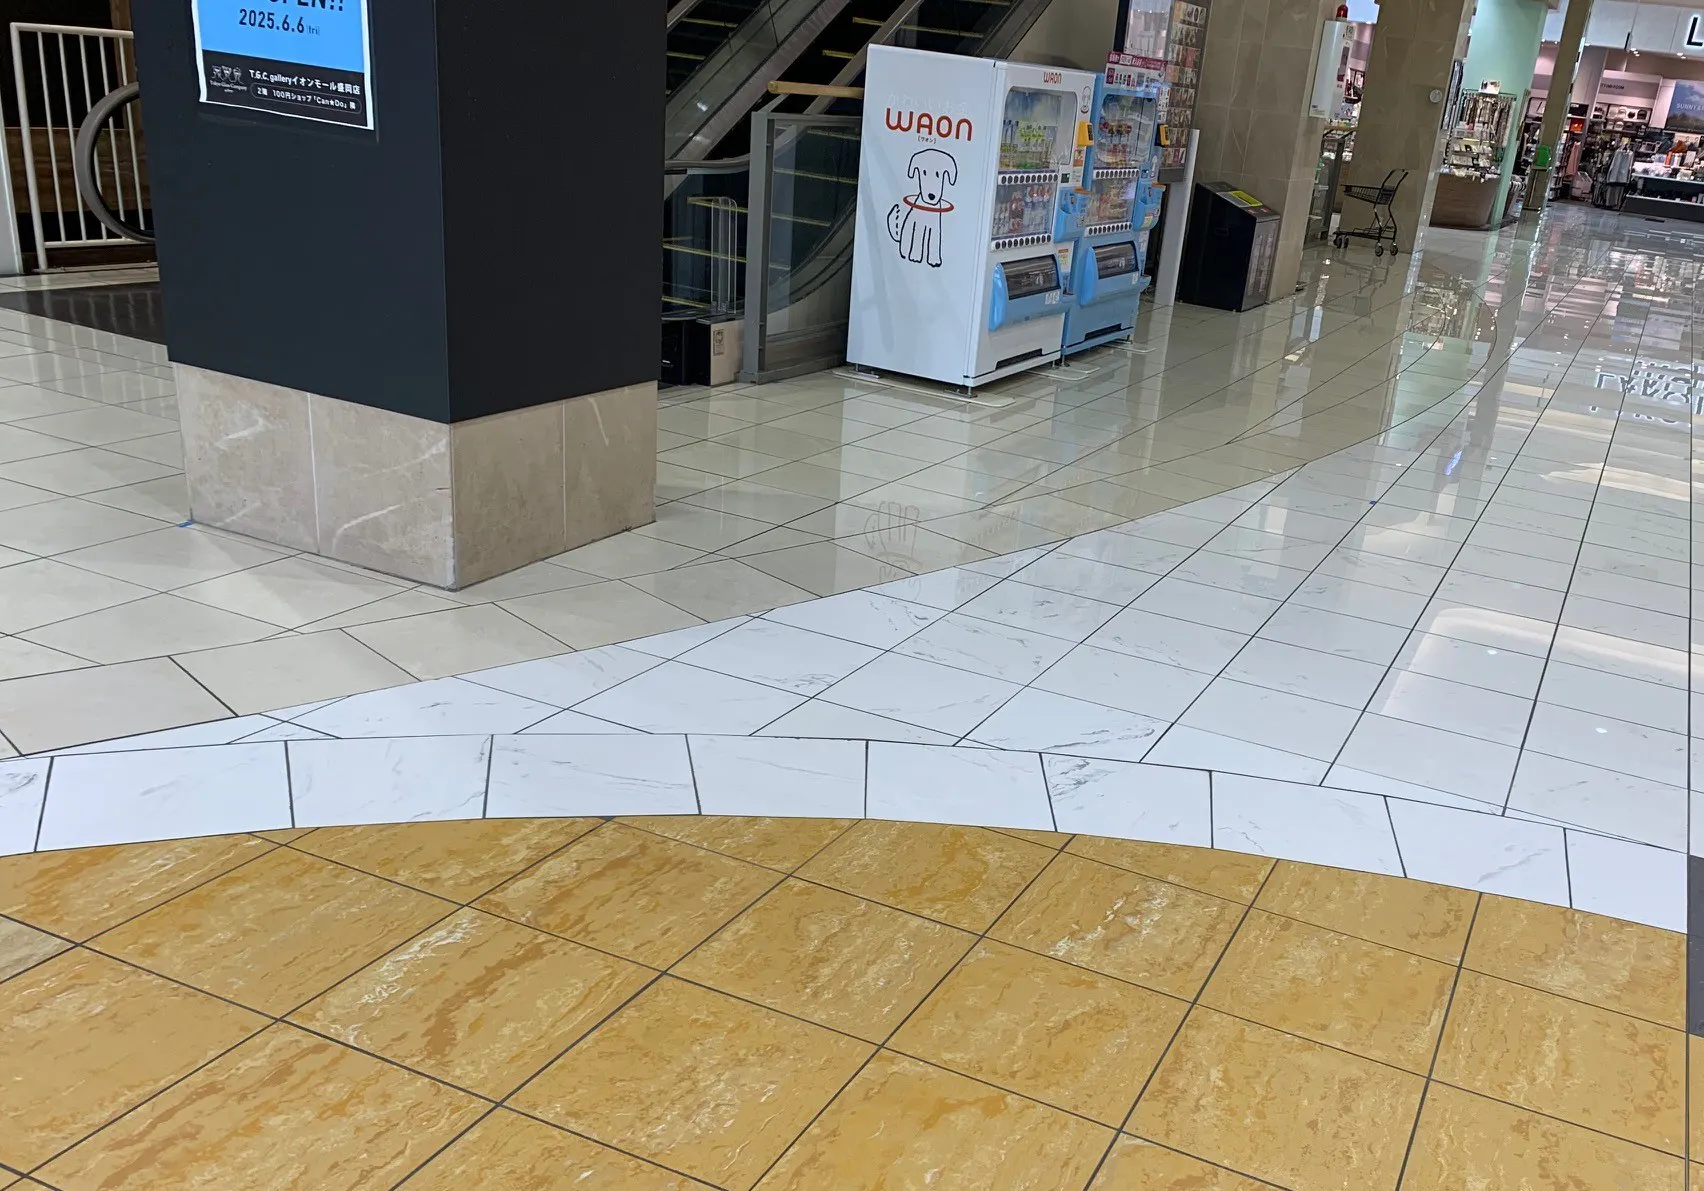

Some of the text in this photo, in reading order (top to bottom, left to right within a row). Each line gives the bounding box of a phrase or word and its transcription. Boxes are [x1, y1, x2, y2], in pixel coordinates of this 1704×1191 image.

[239, 8, 304, 33] 2025.6.6
[1043, 71, 1062, 84] WAON
[885, 107, 973, 142] WAON
